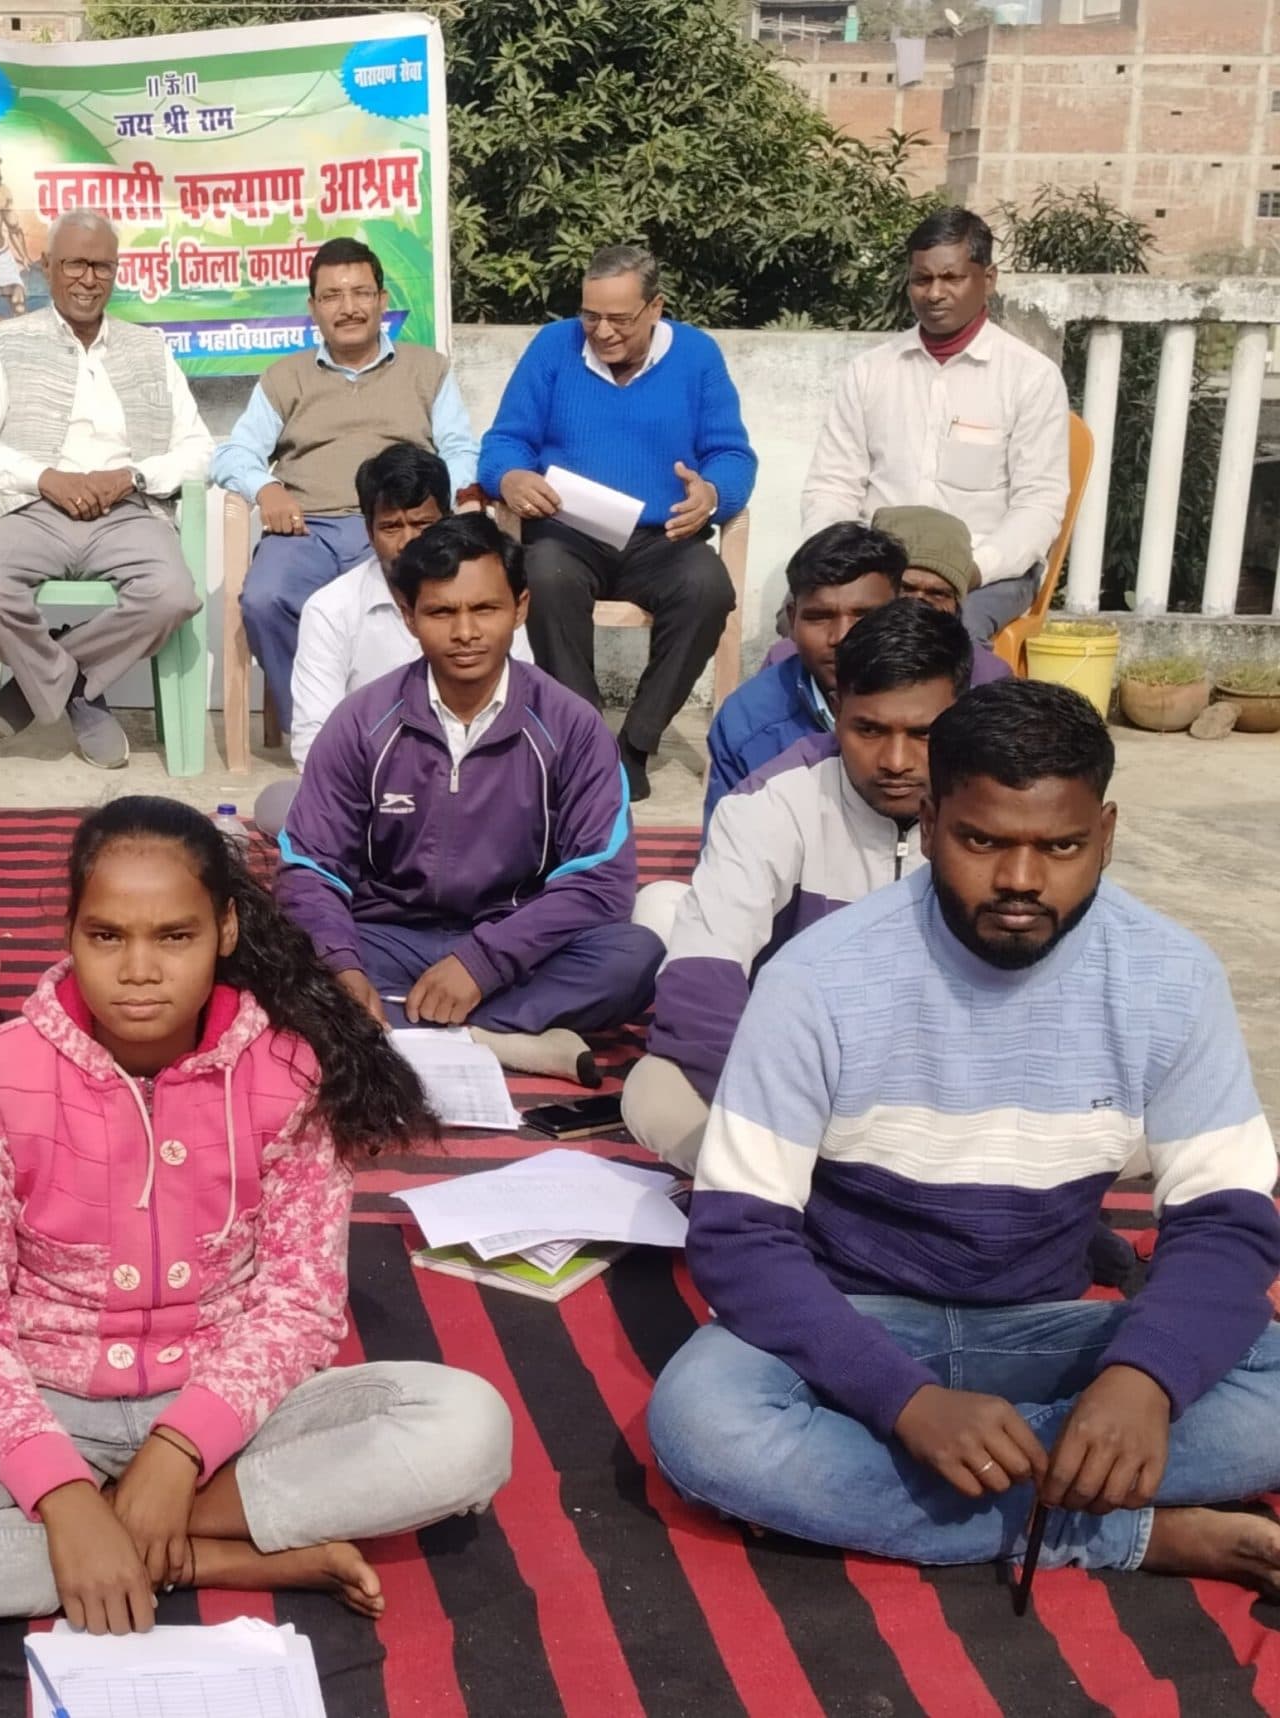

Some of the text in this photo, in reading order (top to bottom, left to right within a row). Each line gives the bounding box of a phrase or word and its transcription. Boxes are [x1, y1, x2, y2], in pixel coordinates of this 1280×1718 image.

[400, 57, 422, 82] सेवा
[114, 105, 234, 136] जय श्री राम
[34, 156, 418, 220] वनवासी कल्याण आश्रम
[118, 241, 171, 299] जमुई
[179, 241, 240, 285] जिला
